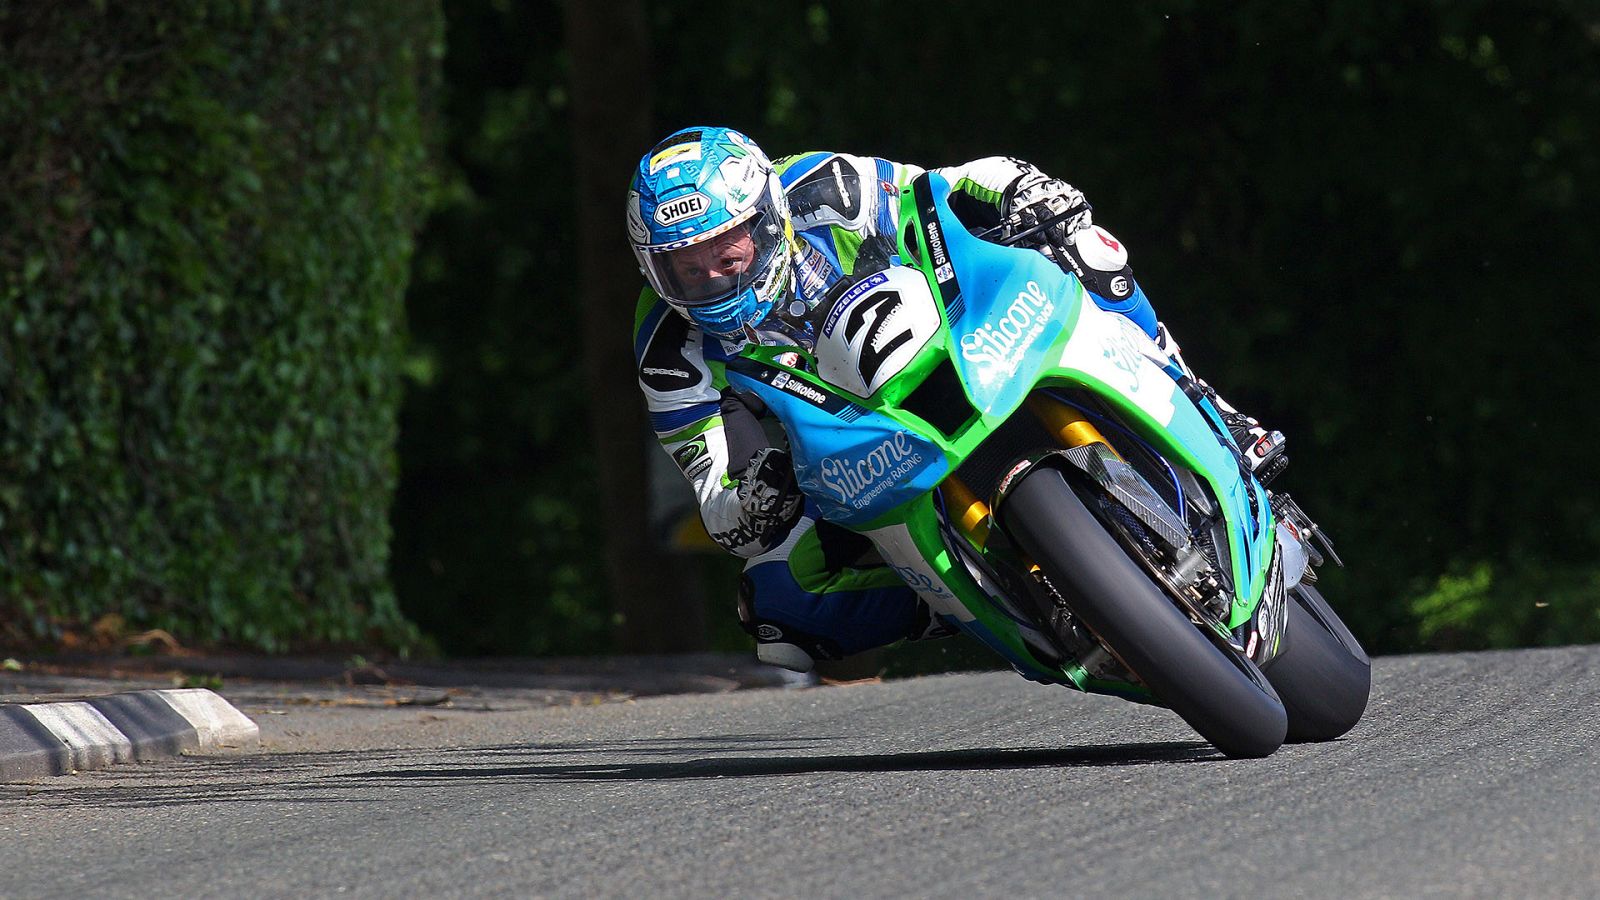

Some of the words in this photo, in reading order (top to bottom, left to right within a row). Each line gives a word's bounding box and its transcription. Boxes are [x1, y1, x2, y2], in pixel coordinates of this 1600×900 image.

[661, 197, 702, 221] SHOEI
[927, 221, 946, 265] Silkolene
[824, 283, 871, 335] METZELER
[961, 281, 1047, 364] Silicone
[843, 289, 915, 391] 2
[785, 379, 826, 404] Silkolene
[821, 431, 912, 504] Silicone
[852, 477, 894, 509] Engineering
[890, 453, 922, 480] RACING
